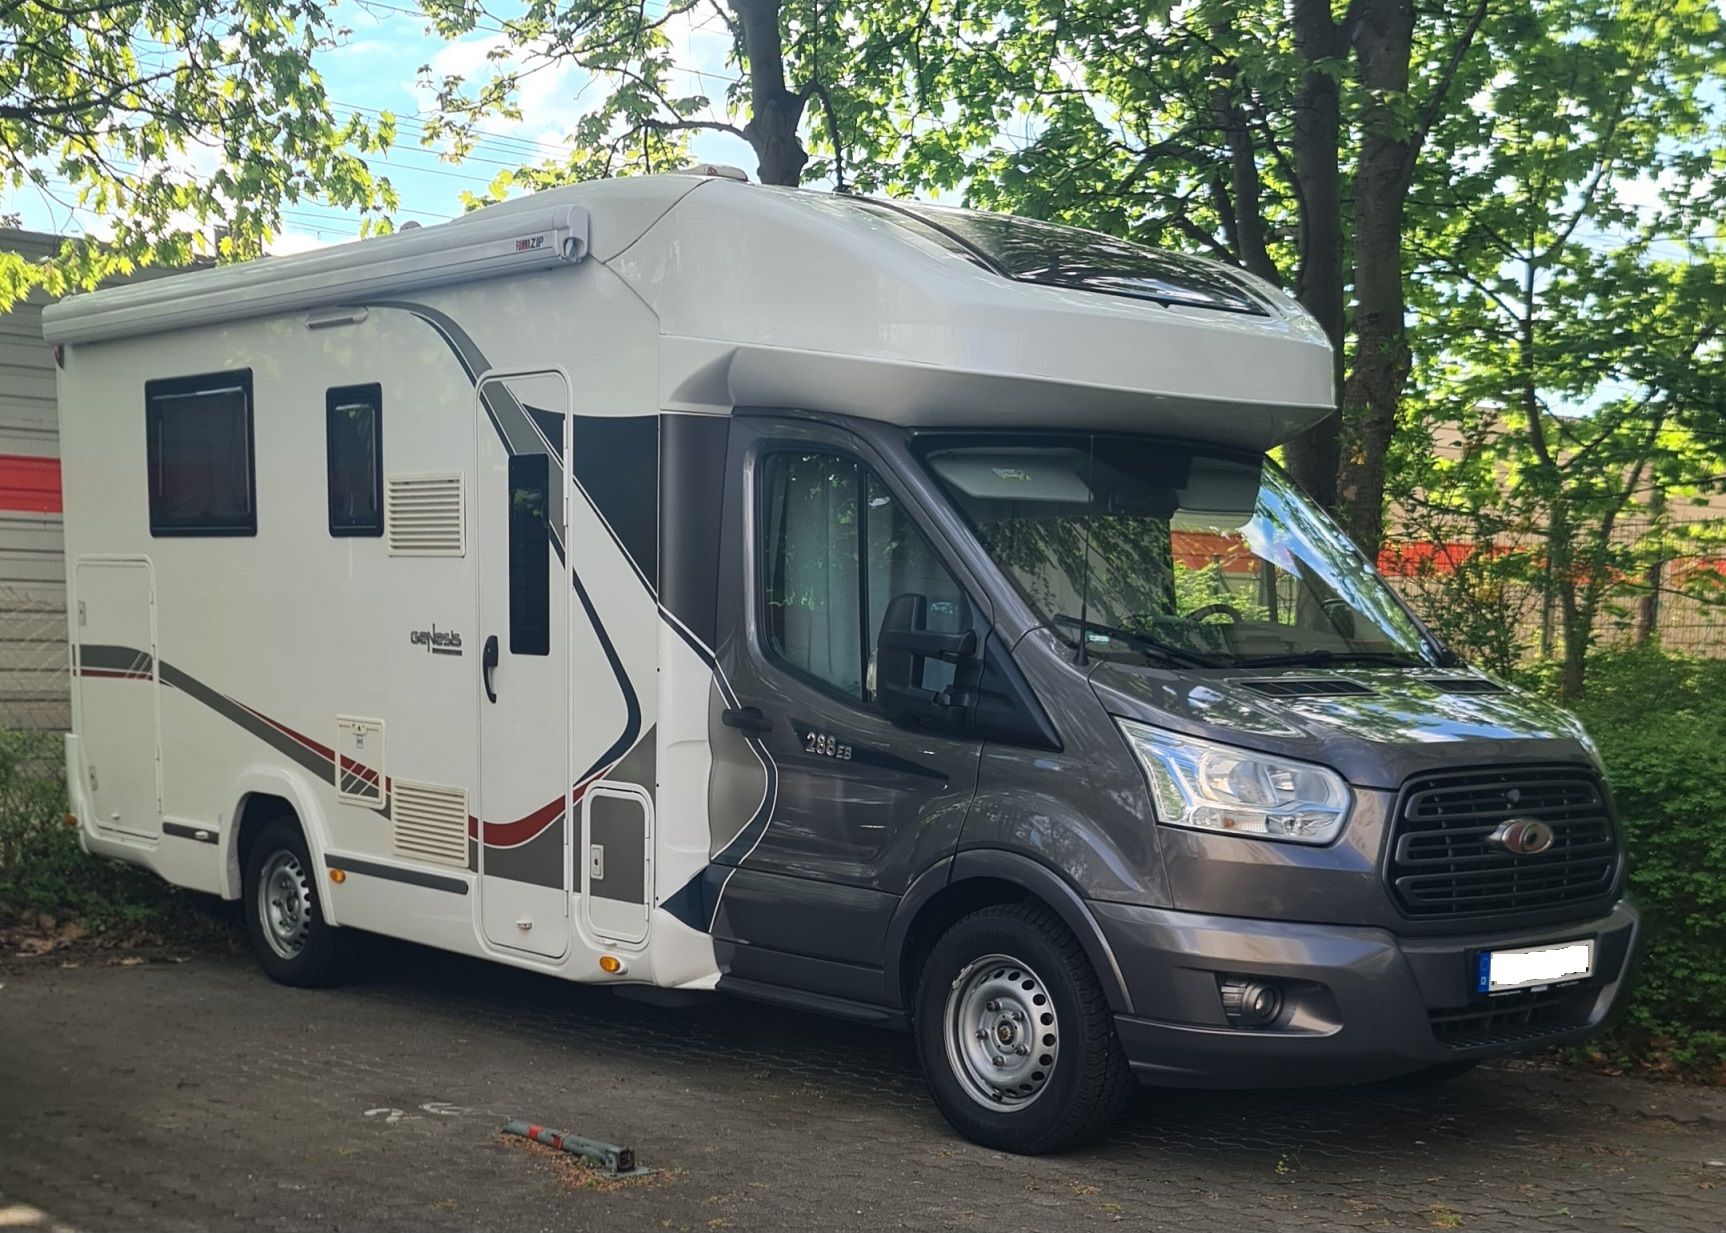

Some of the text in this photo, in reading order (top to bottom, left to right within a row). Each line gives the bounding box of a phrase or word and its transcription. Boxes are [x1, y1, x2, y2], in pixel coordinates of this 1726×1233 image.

[530, 236, 544, 249] ZIP
[805, 732, 852, 760] 288 EB
